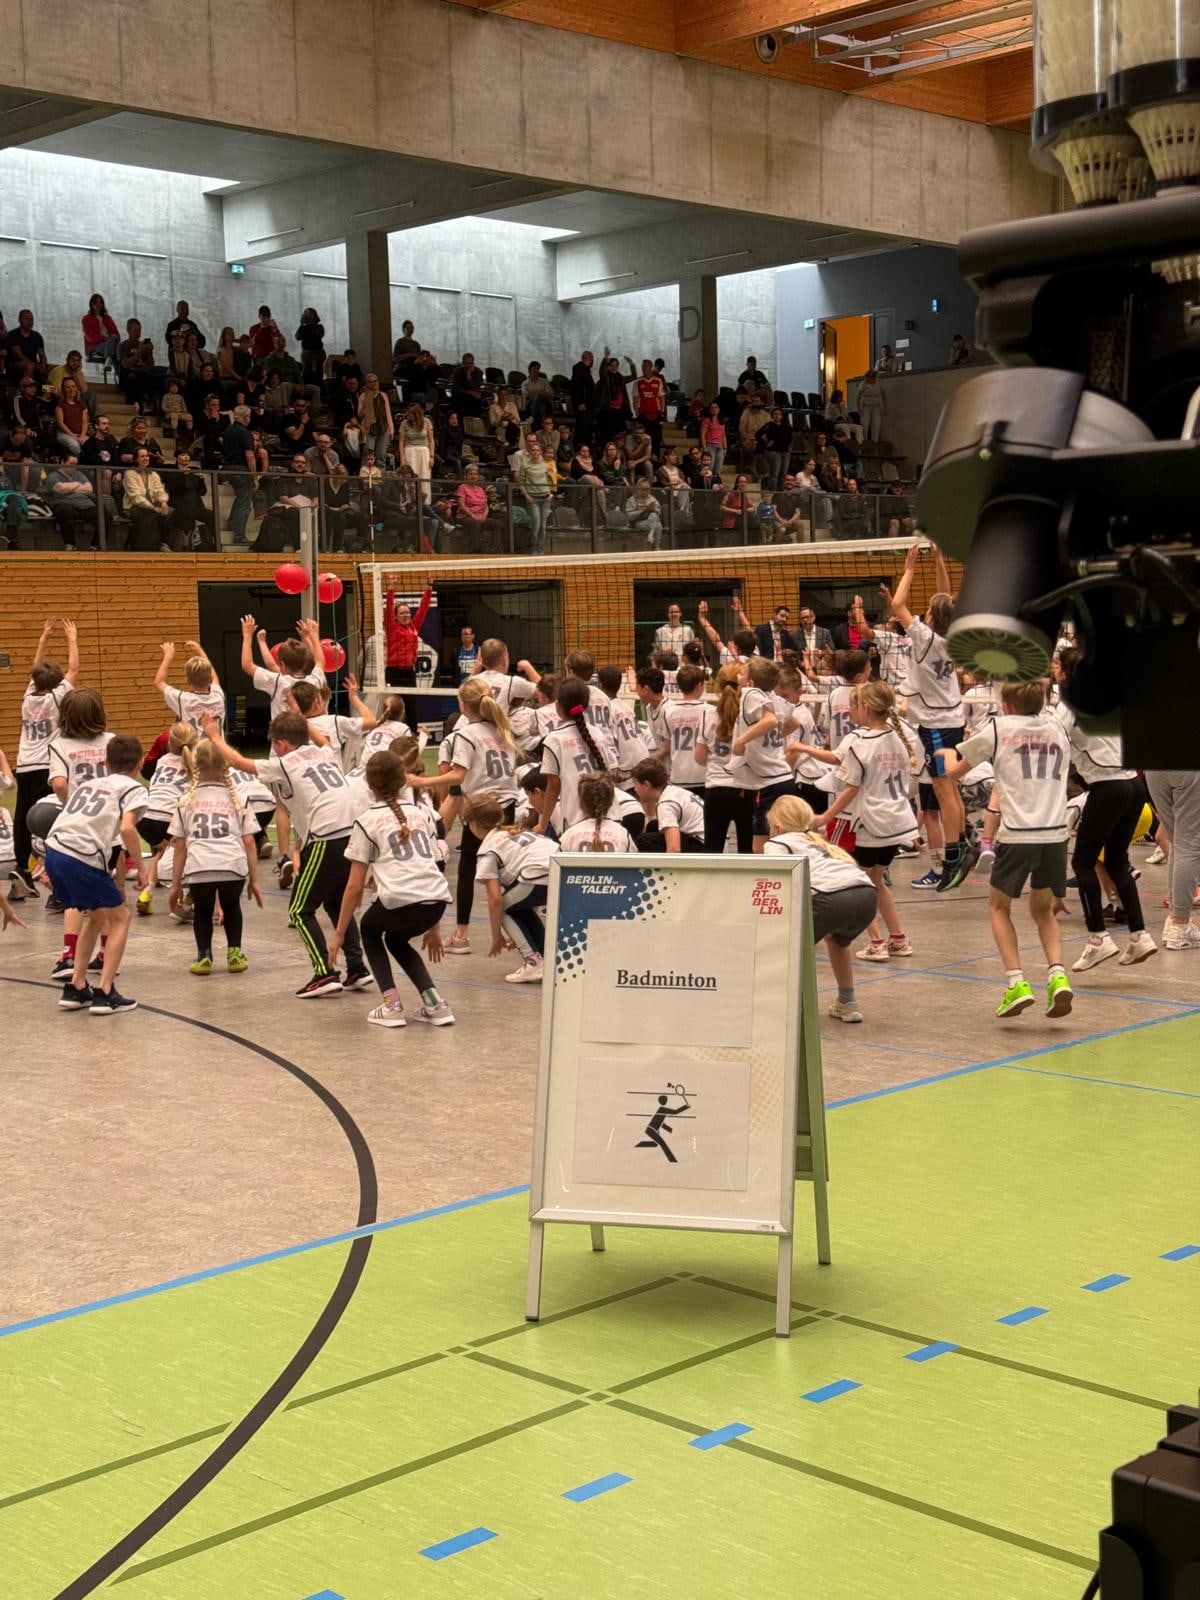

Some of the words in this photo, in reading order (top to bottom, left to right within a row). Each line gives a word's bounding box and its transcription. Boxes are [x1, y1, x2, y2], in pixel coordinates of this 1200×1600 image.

[678, 306, 702, 343] D
[66, 786, 111, 817] 65
[193, 812, 230, 839] 35
[567, 875, 613, 884] BERLIN
[581, 885, 627, 894] TALENT
[756, 881, 782, 890] SPO
[752, 890, 769, 898] RT
[752, 898, 779, 906] BER
[760, 906, 783, 915] LIN
[616, 969, 718, 988] Badminton
